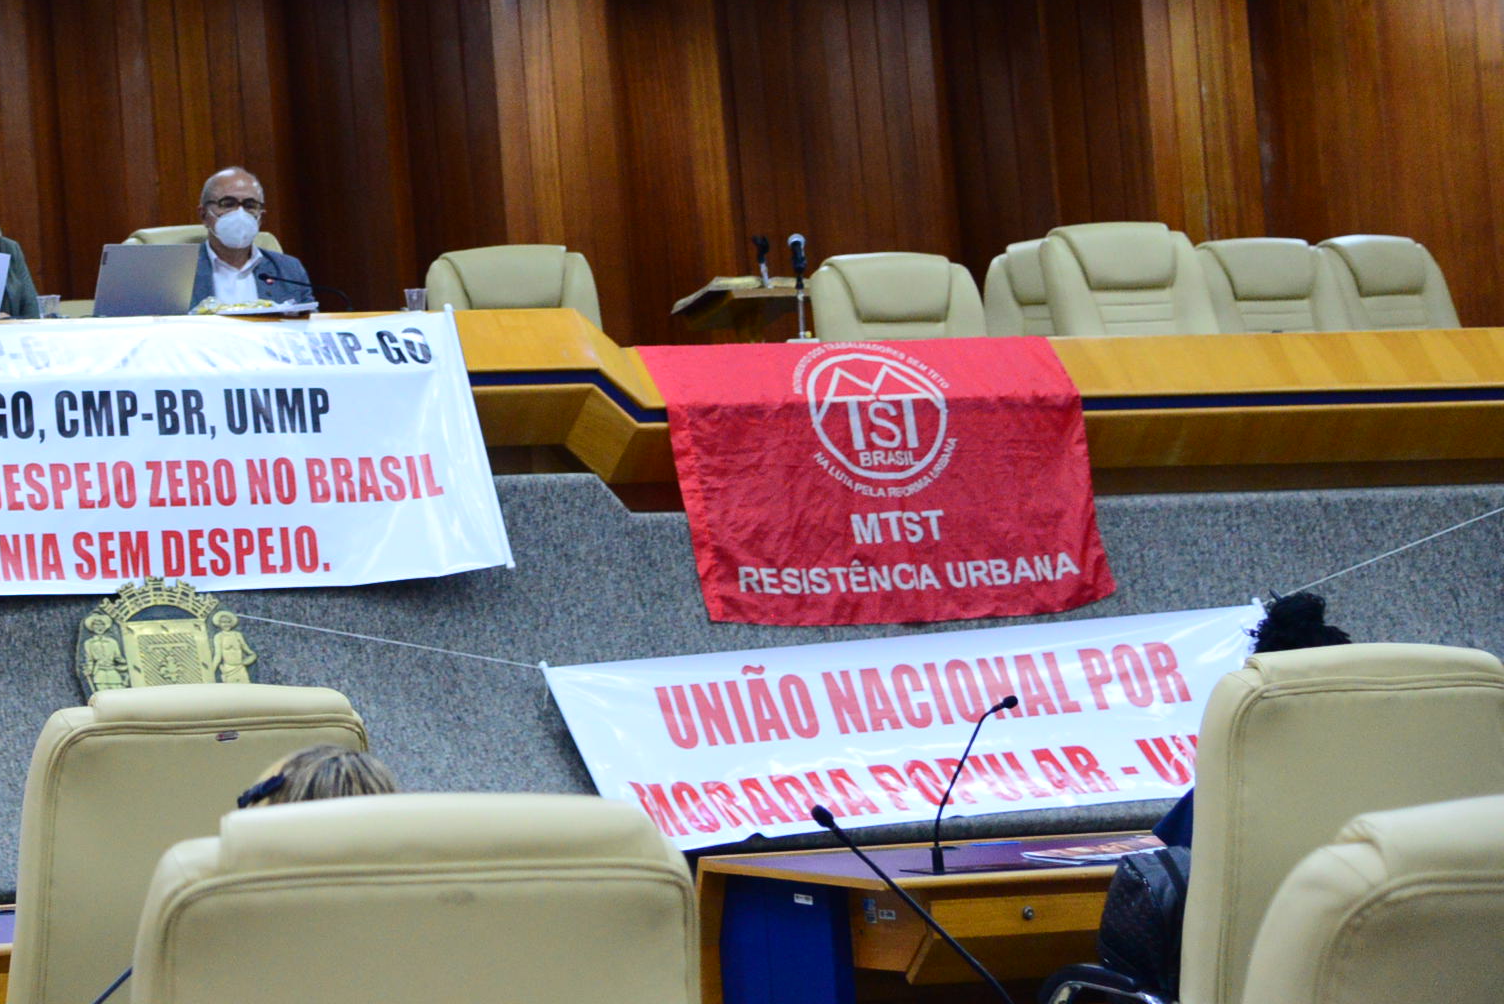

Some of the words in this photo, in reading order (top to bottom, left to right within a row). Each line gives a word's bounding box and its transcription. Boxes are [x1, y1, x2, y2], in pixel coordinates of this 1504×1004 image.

[906, 355, 928, 372] SEM
[927, 370, 950, 389] TETO
[55, 389, 216, 440] CMP-BR,
[224, 387, 330, 435] UNMP
[146, 458, 237, 508] ZERO
[245, 457, 296, 505] NO
[306, 453, 444, 504] BRASIL
[813, 452, 830, 469] NA
[828, 465, 855, 489] LUTA
[853, 483, 886, 497] PELA
[859, 450, 917, 467] BRASIL
[851, 510, 944, 545] MTST
[72, 529, 151, 580] SEM
[161, 525, 331, 578] DESPEJO.
[738, 560, 941, 595] RESISTÊNCIA
[946, 551, 1080, 588] URBANA
[654, 664, 821, 750] UNIÃO
[821, 652, 1082, 735] NACIONAL
[1076, 641, 1193, 711] POR
[628, 768, 882, 838] MORADIA
[867, 745, 1119, 815] POPULAR
